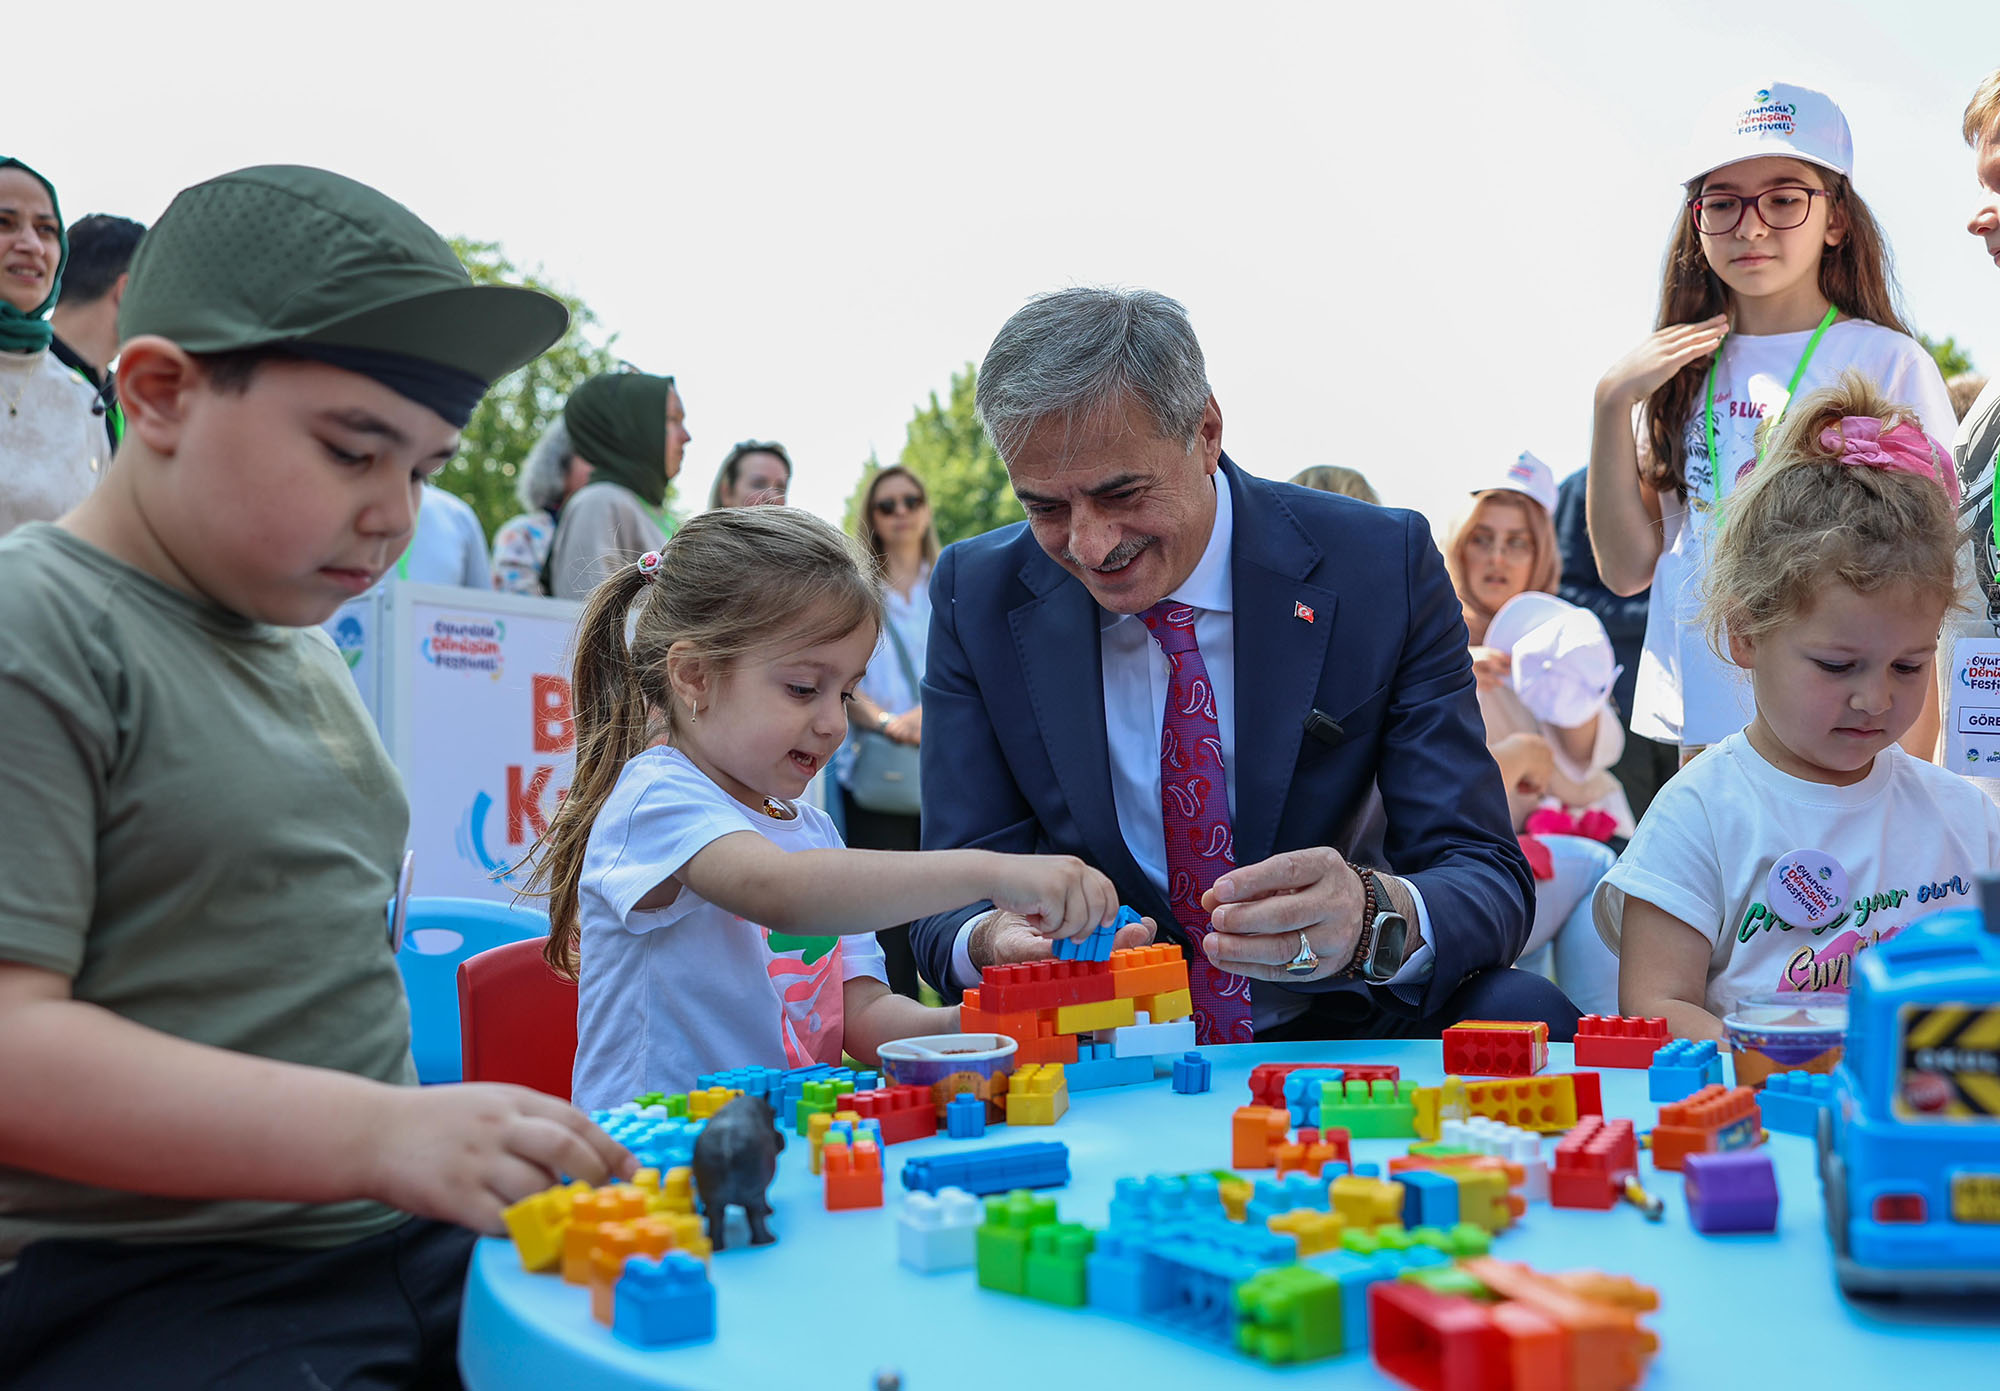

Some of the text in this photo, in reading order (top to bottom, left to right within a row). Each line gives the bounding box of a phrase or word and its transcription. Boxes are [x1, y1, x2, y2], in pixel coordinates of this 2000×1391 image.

[1730, 401, 1767, 418] BLUE
[1781, 878, 1819, 916] Festivali
[1787, 869, 1828, 911] Dönüşüm
[1796, 865, 1833, 902] Oyuncak
[1854, 889, 1909, 927] your
[1917, 875, 1971, 903] own
